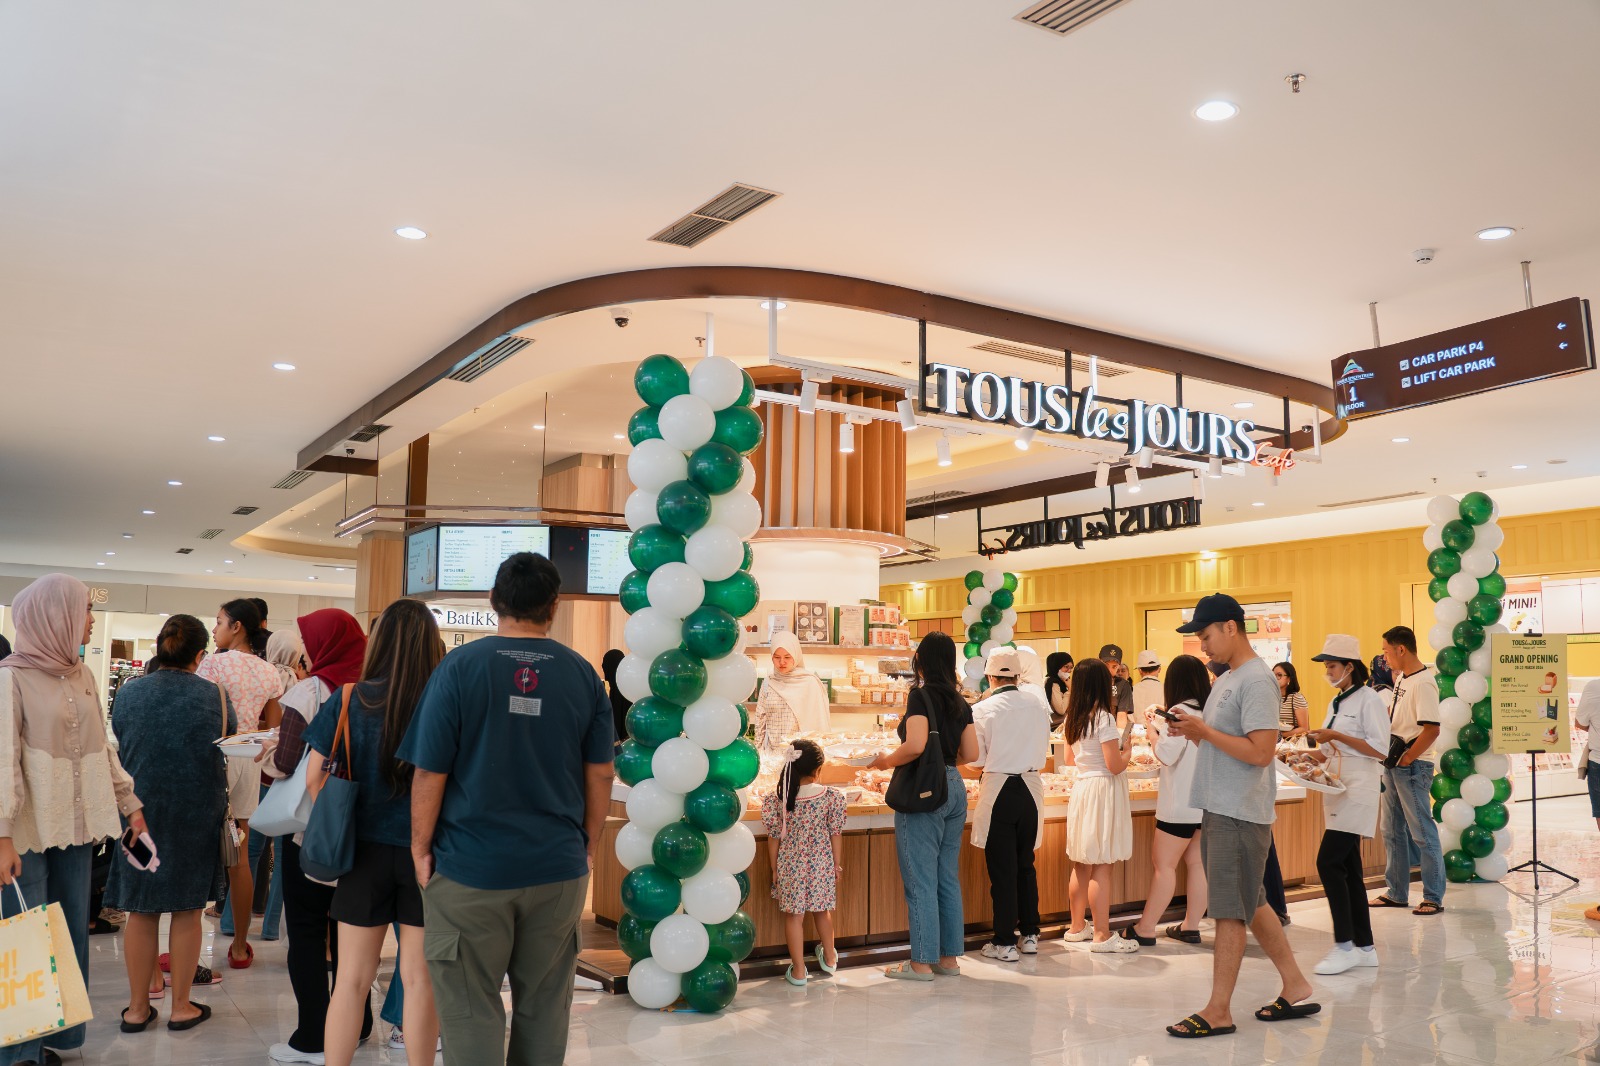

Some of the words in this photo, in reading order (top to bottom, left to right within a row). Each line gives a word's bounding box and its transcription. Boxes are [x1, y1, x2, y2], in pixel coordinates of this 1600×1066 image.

[1412, 353, 1435, 367] CAR
[1437, 345, 1467, 361] PARK
[1469, 341, 1484, 354] P4
[1413, 370, 1437, 385] LIFT
[1439, 364, 1463, 379] CAR
[1464, 357, 1496, 373] PARK
[1349, 386, 1358, 401] 1
[932, 362, 1070, 432] TOUS
[1079, 385, 1129, 441] les
[1126, 400, 1256, 461] JOURS
[1345, 402, 1365, 412] FLOOR
[1508, 597, 1537, 609] MINI!
[1500, 655, 1524, 663] GRAND
[1527, 655, 1559, 663] OPENING
